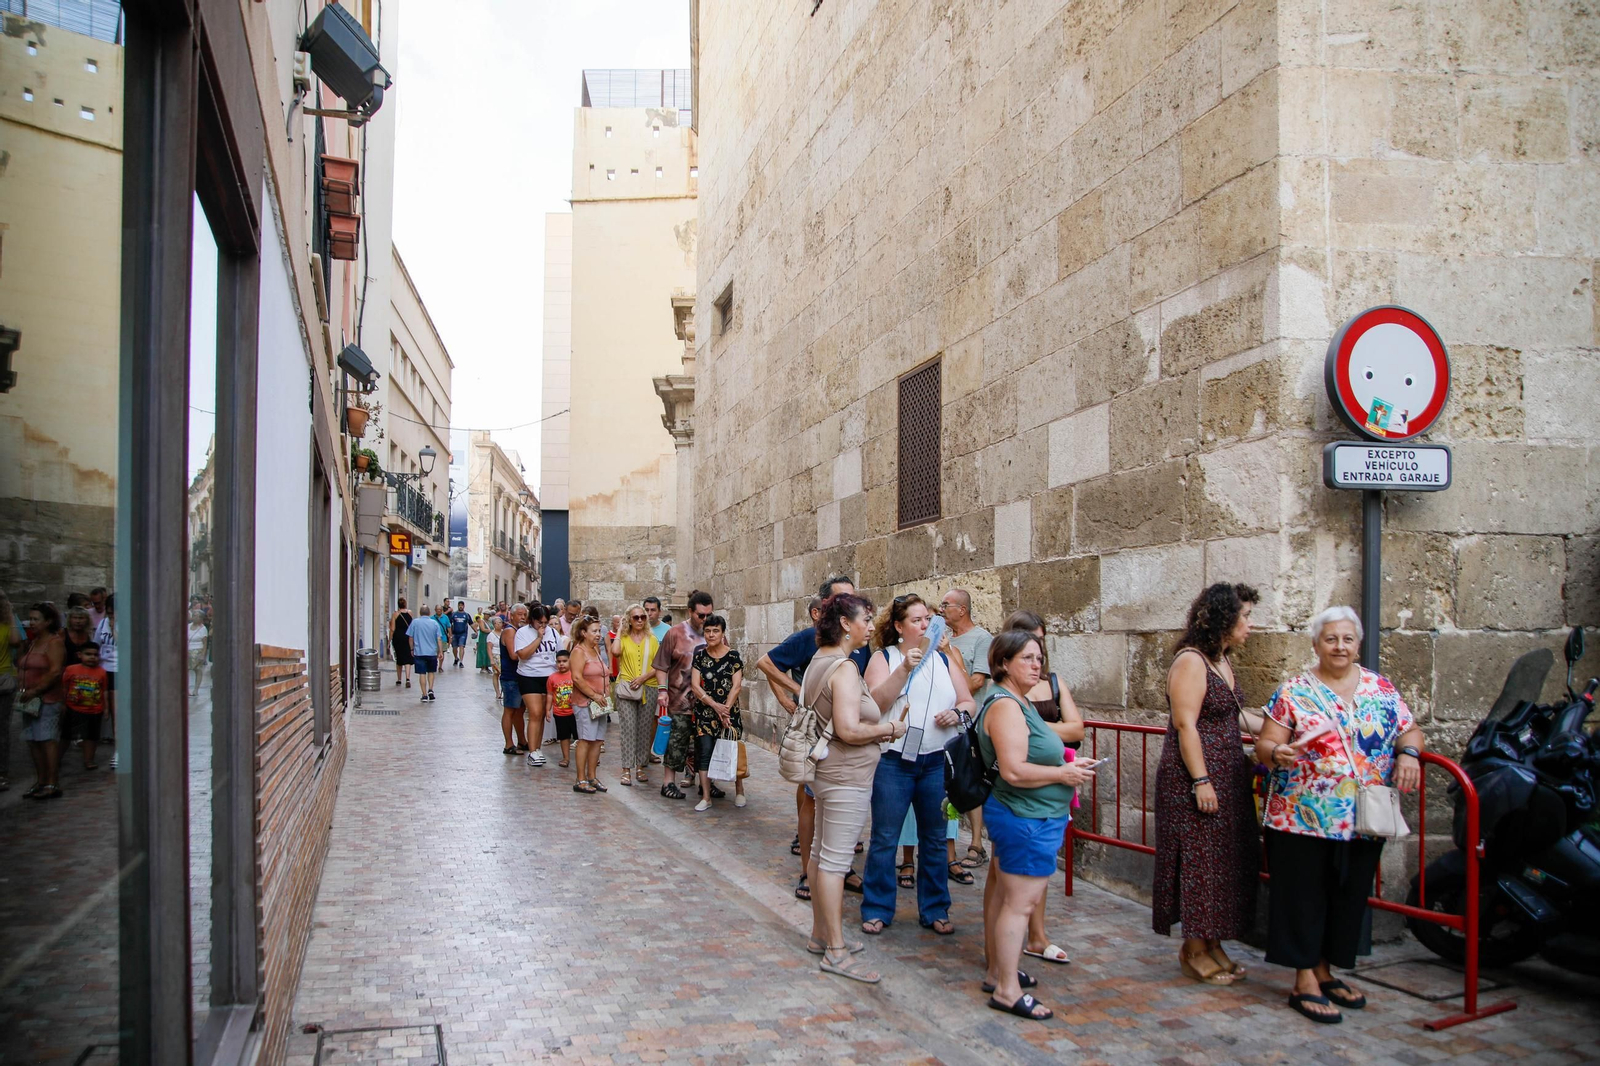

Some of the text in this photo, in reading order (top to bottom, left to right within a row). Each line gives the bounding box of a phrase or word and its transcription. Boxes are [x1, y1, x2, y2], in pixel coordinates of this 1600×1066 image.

[1367, 449, 1416, 460] EXCEPTO
[1364, 459, 1419, 471] VEHÍCULO
[1342, 471, 1440, 483] ENTRADA GARAJE
